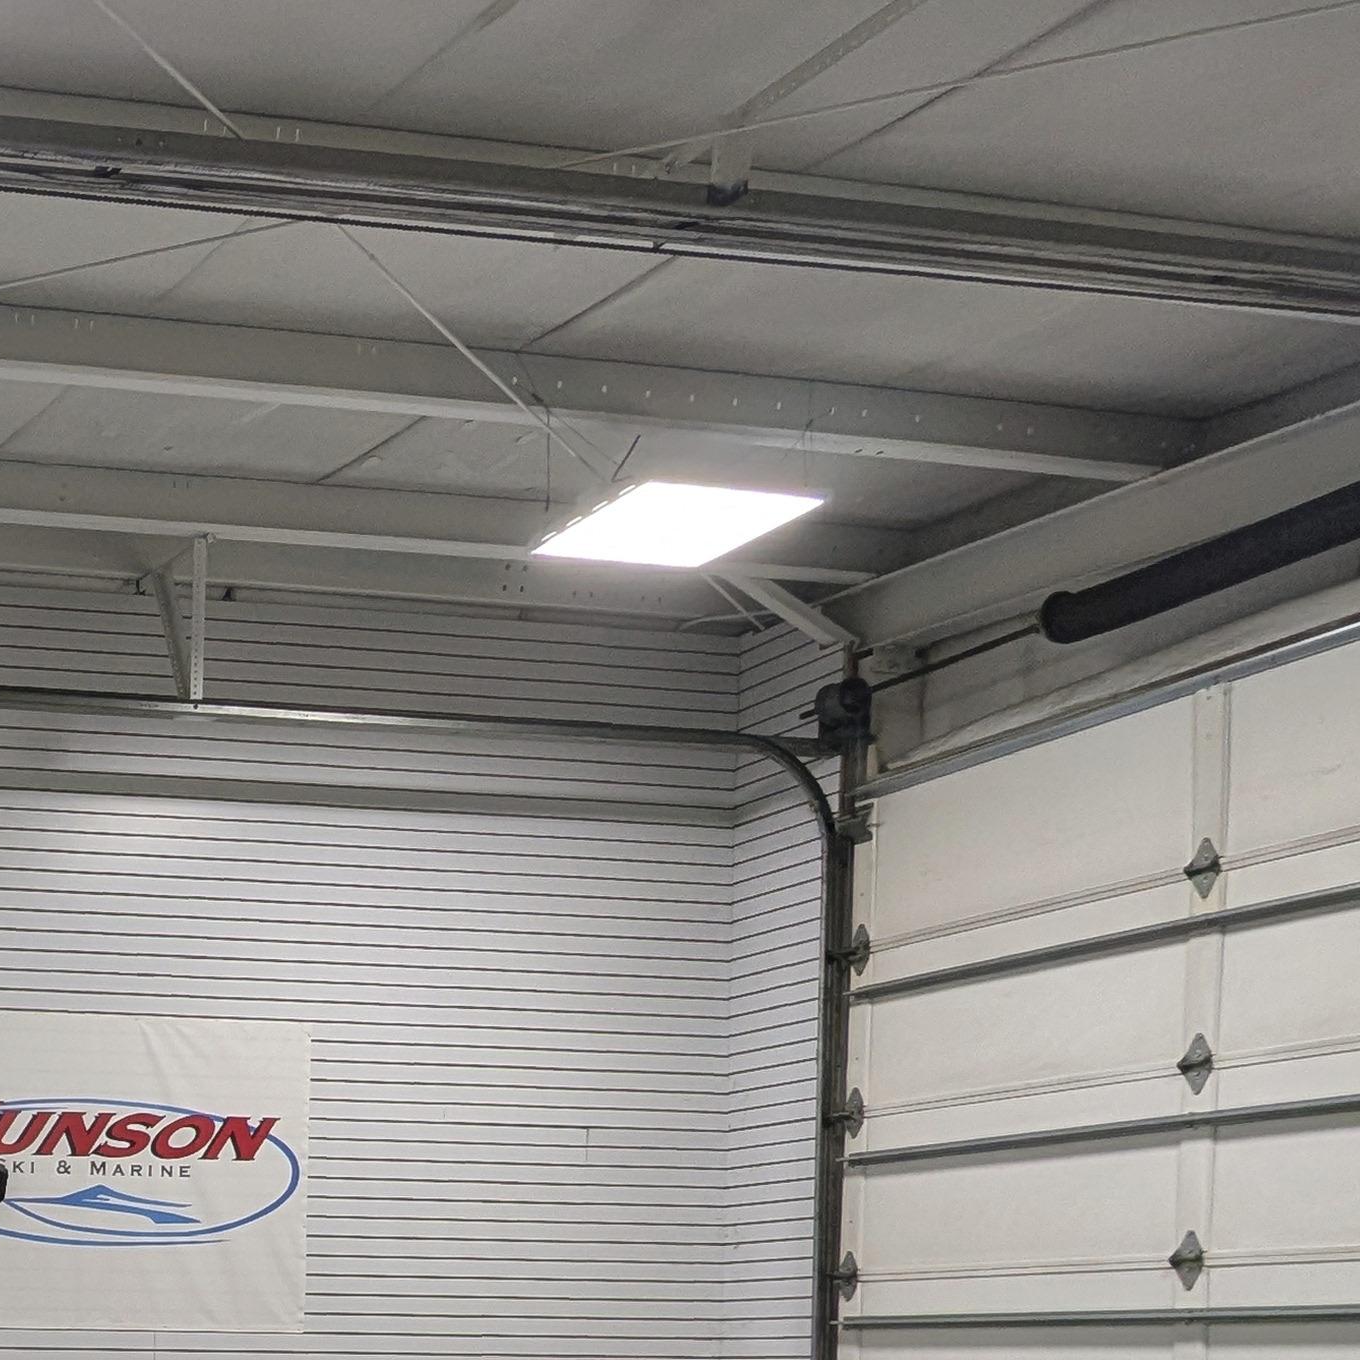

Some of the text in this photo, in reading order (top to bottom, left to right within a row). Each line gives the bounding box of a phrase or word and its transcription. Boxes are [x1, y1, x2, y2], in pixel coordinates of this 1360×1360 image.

[0, 1158, 192, 1178] KI & MARINE
